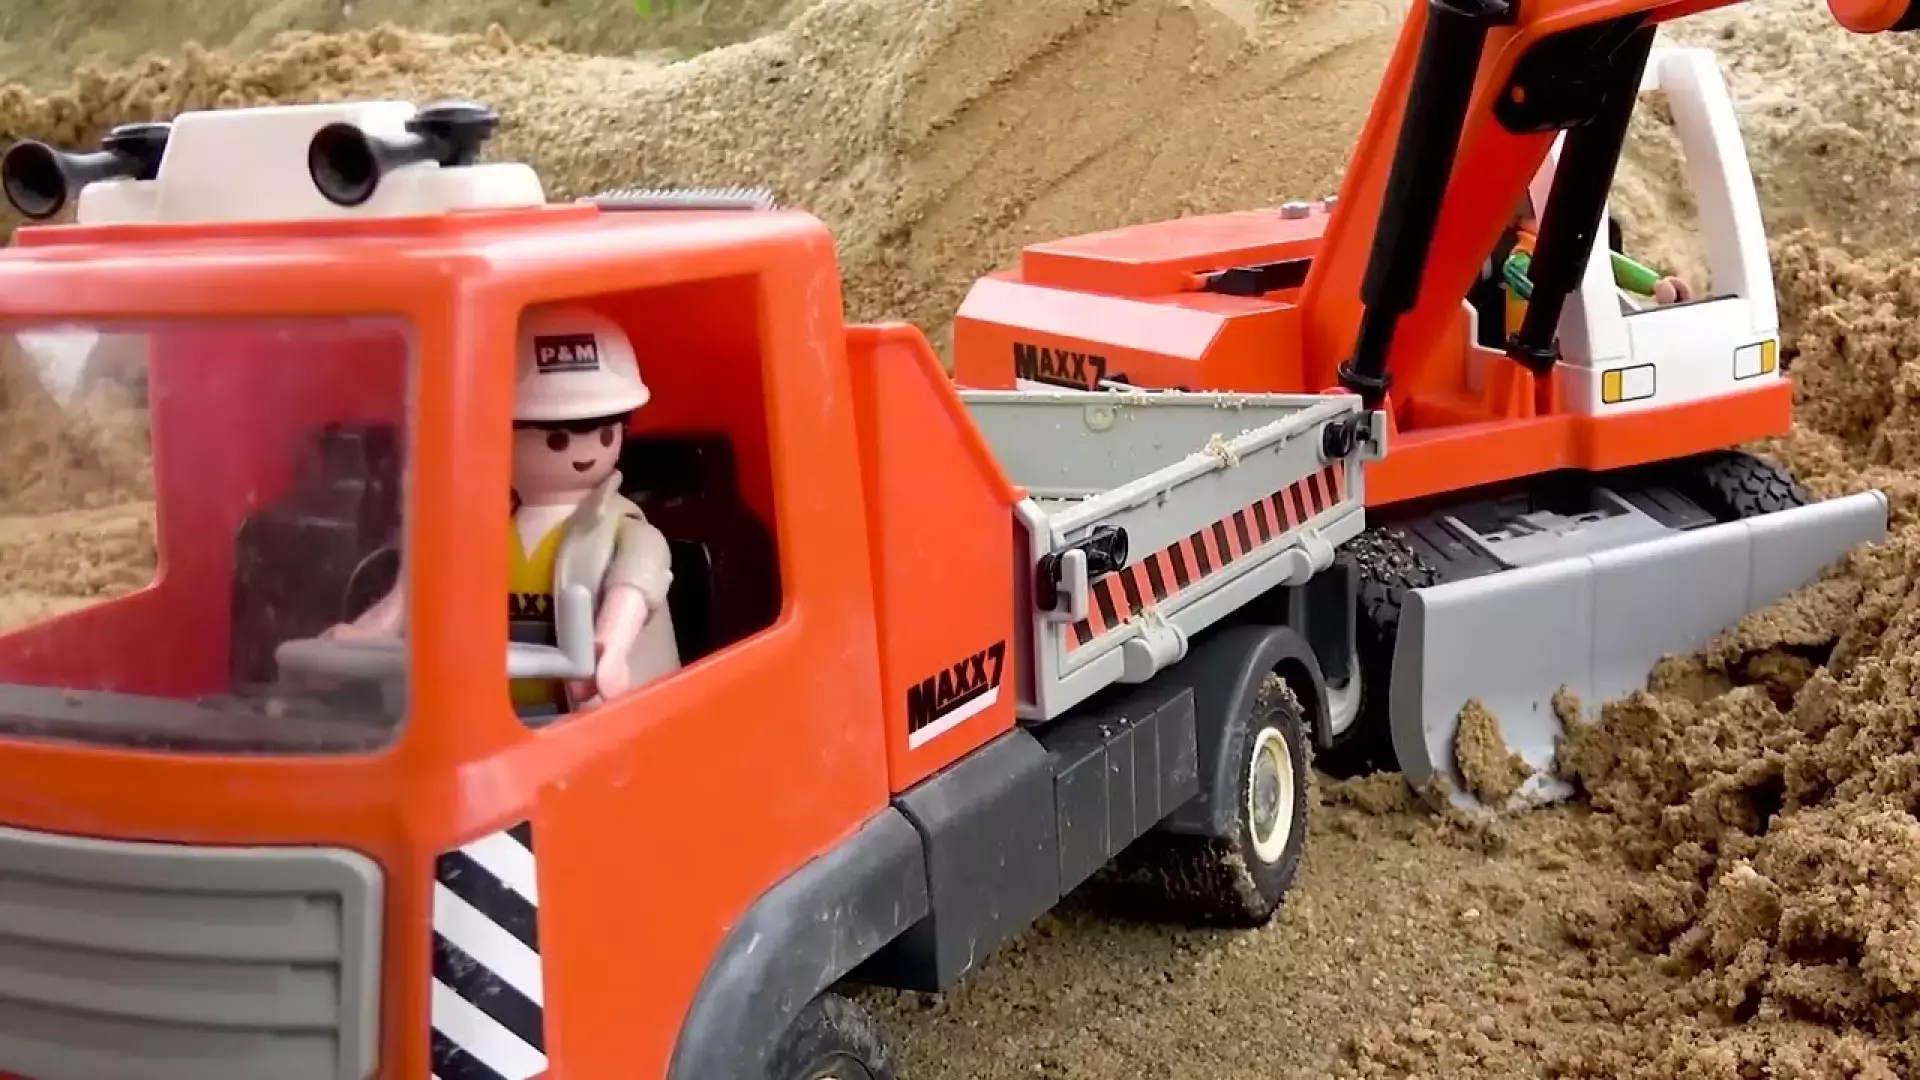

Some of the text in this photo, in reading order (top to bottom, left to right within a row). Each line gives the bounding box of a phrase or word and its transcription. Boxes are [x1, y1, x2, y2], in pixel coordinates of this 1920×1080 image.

[540, 344, 596, 364] P&M
[1013, 341, 1106, 391] MAXX7
[906, 639, 1006, 735] MAXX7
